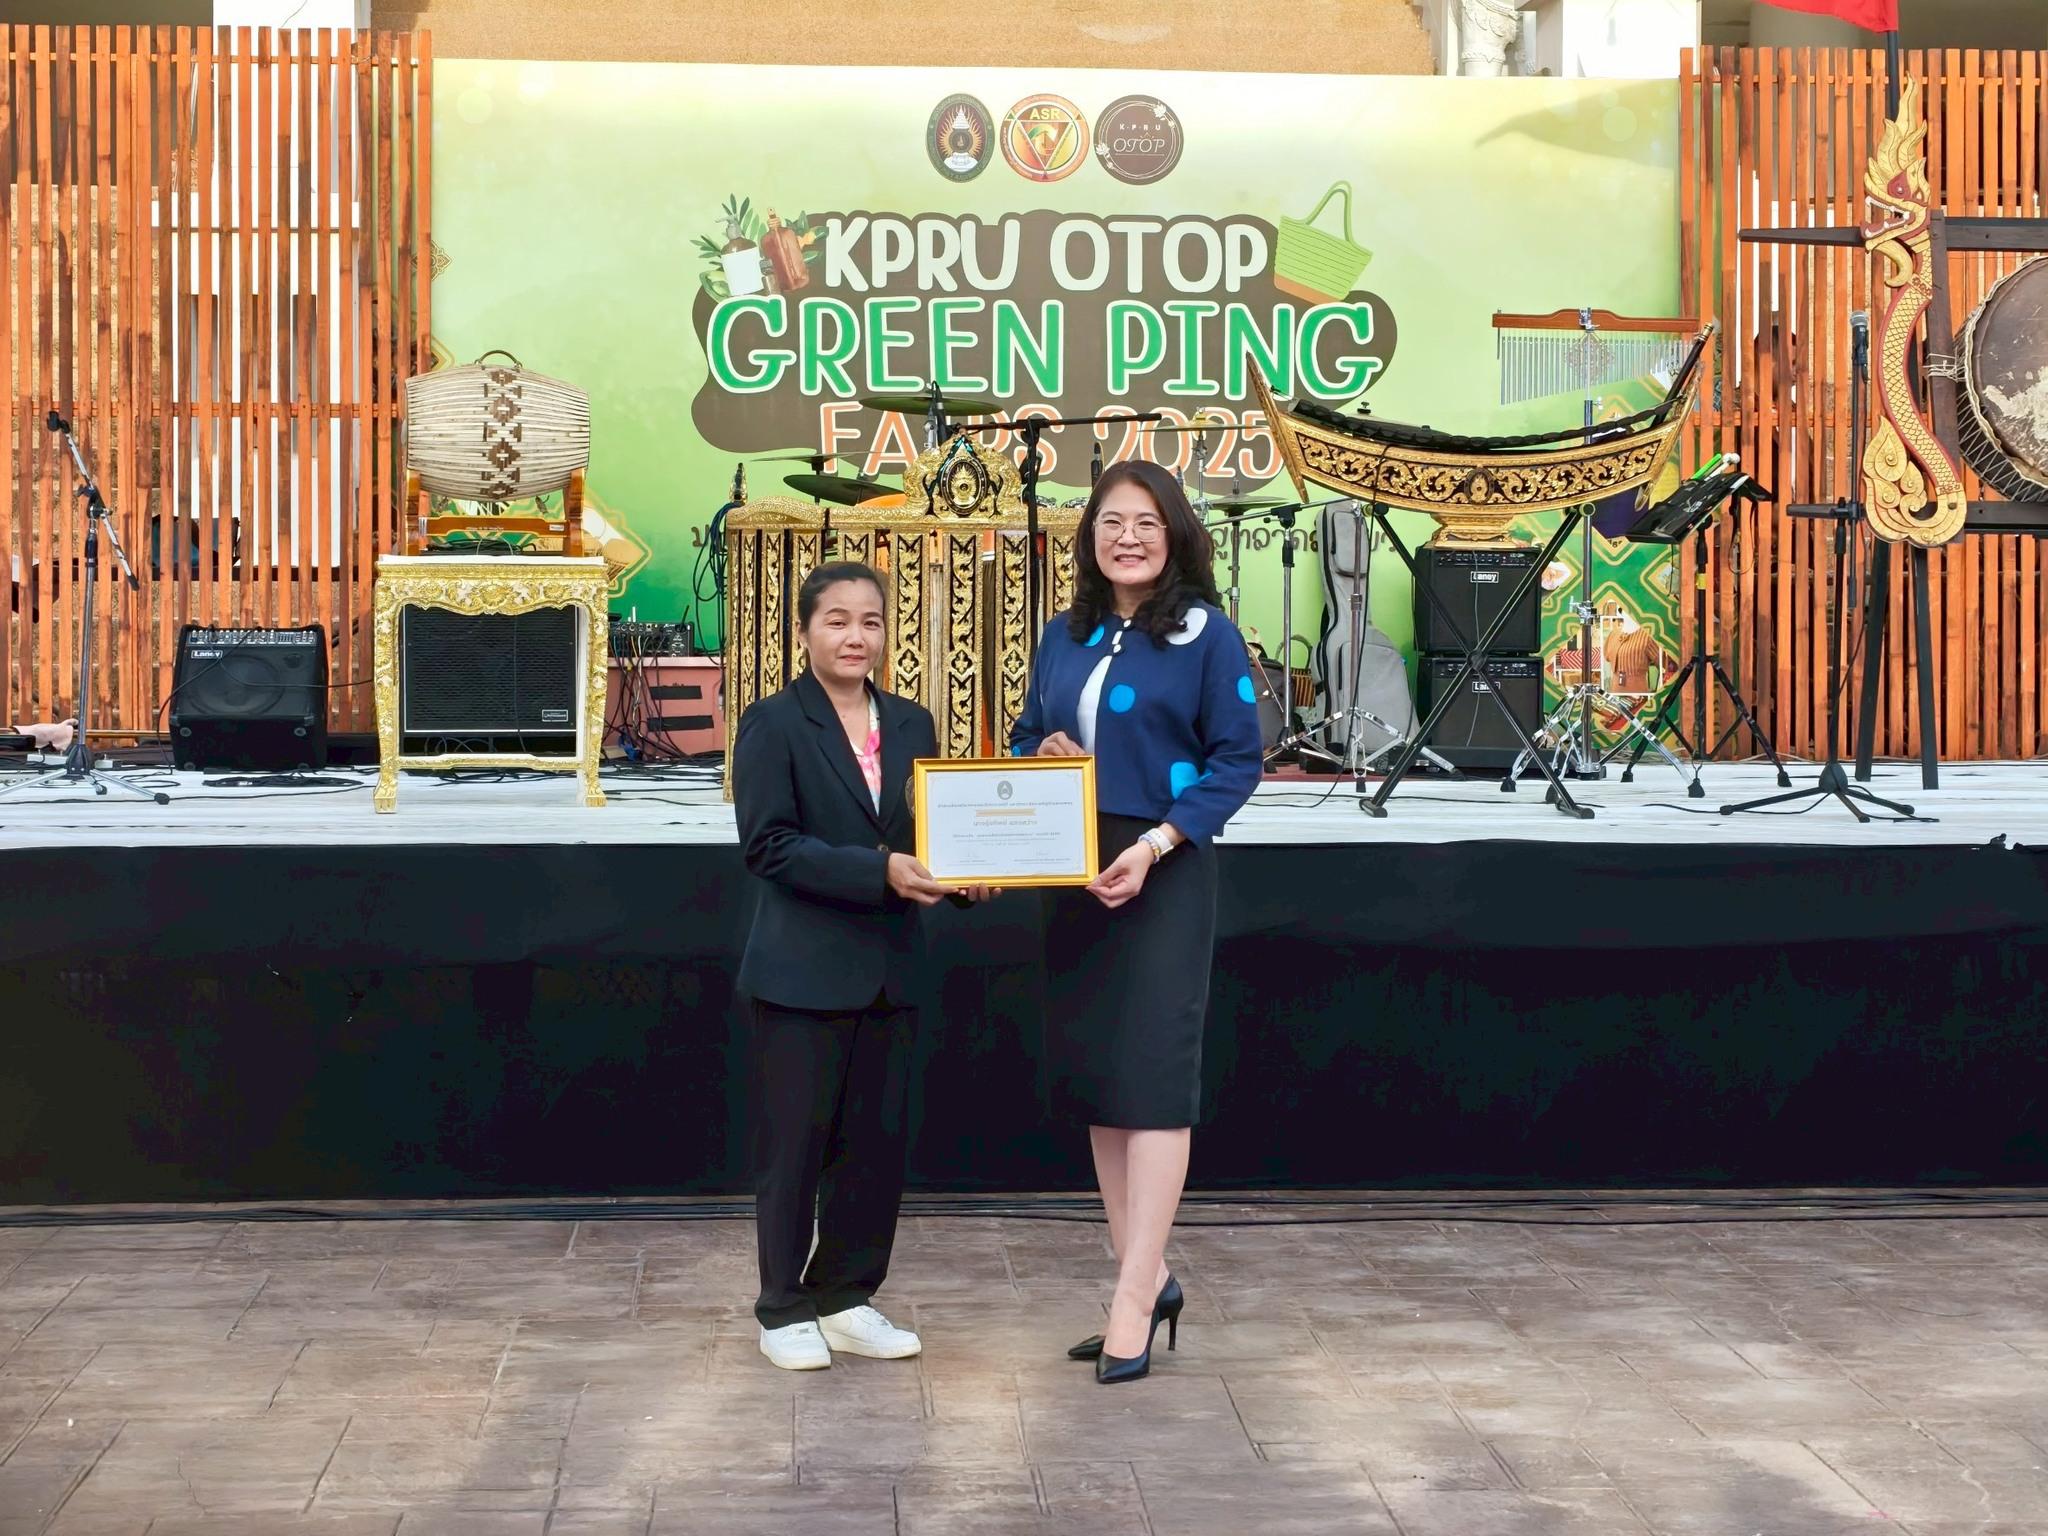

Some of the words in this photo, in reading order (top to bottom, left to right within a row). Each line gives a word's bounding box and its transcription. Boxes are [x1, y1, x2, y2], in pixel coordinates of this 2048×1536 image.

[1030, 108, 1060, 120] ASR
[1113, 138, 1165, 153] OTOP
[825, 217, 1021, 292] KPRU
[1049, 220, 1269, 293] OTOP
[706, 296, 1064, 397] GREEN
[1106, 300, 1383, 401] PING
[819, 401, 1063, 477] FAS
[1093, 404, 1284, 479] 2025
